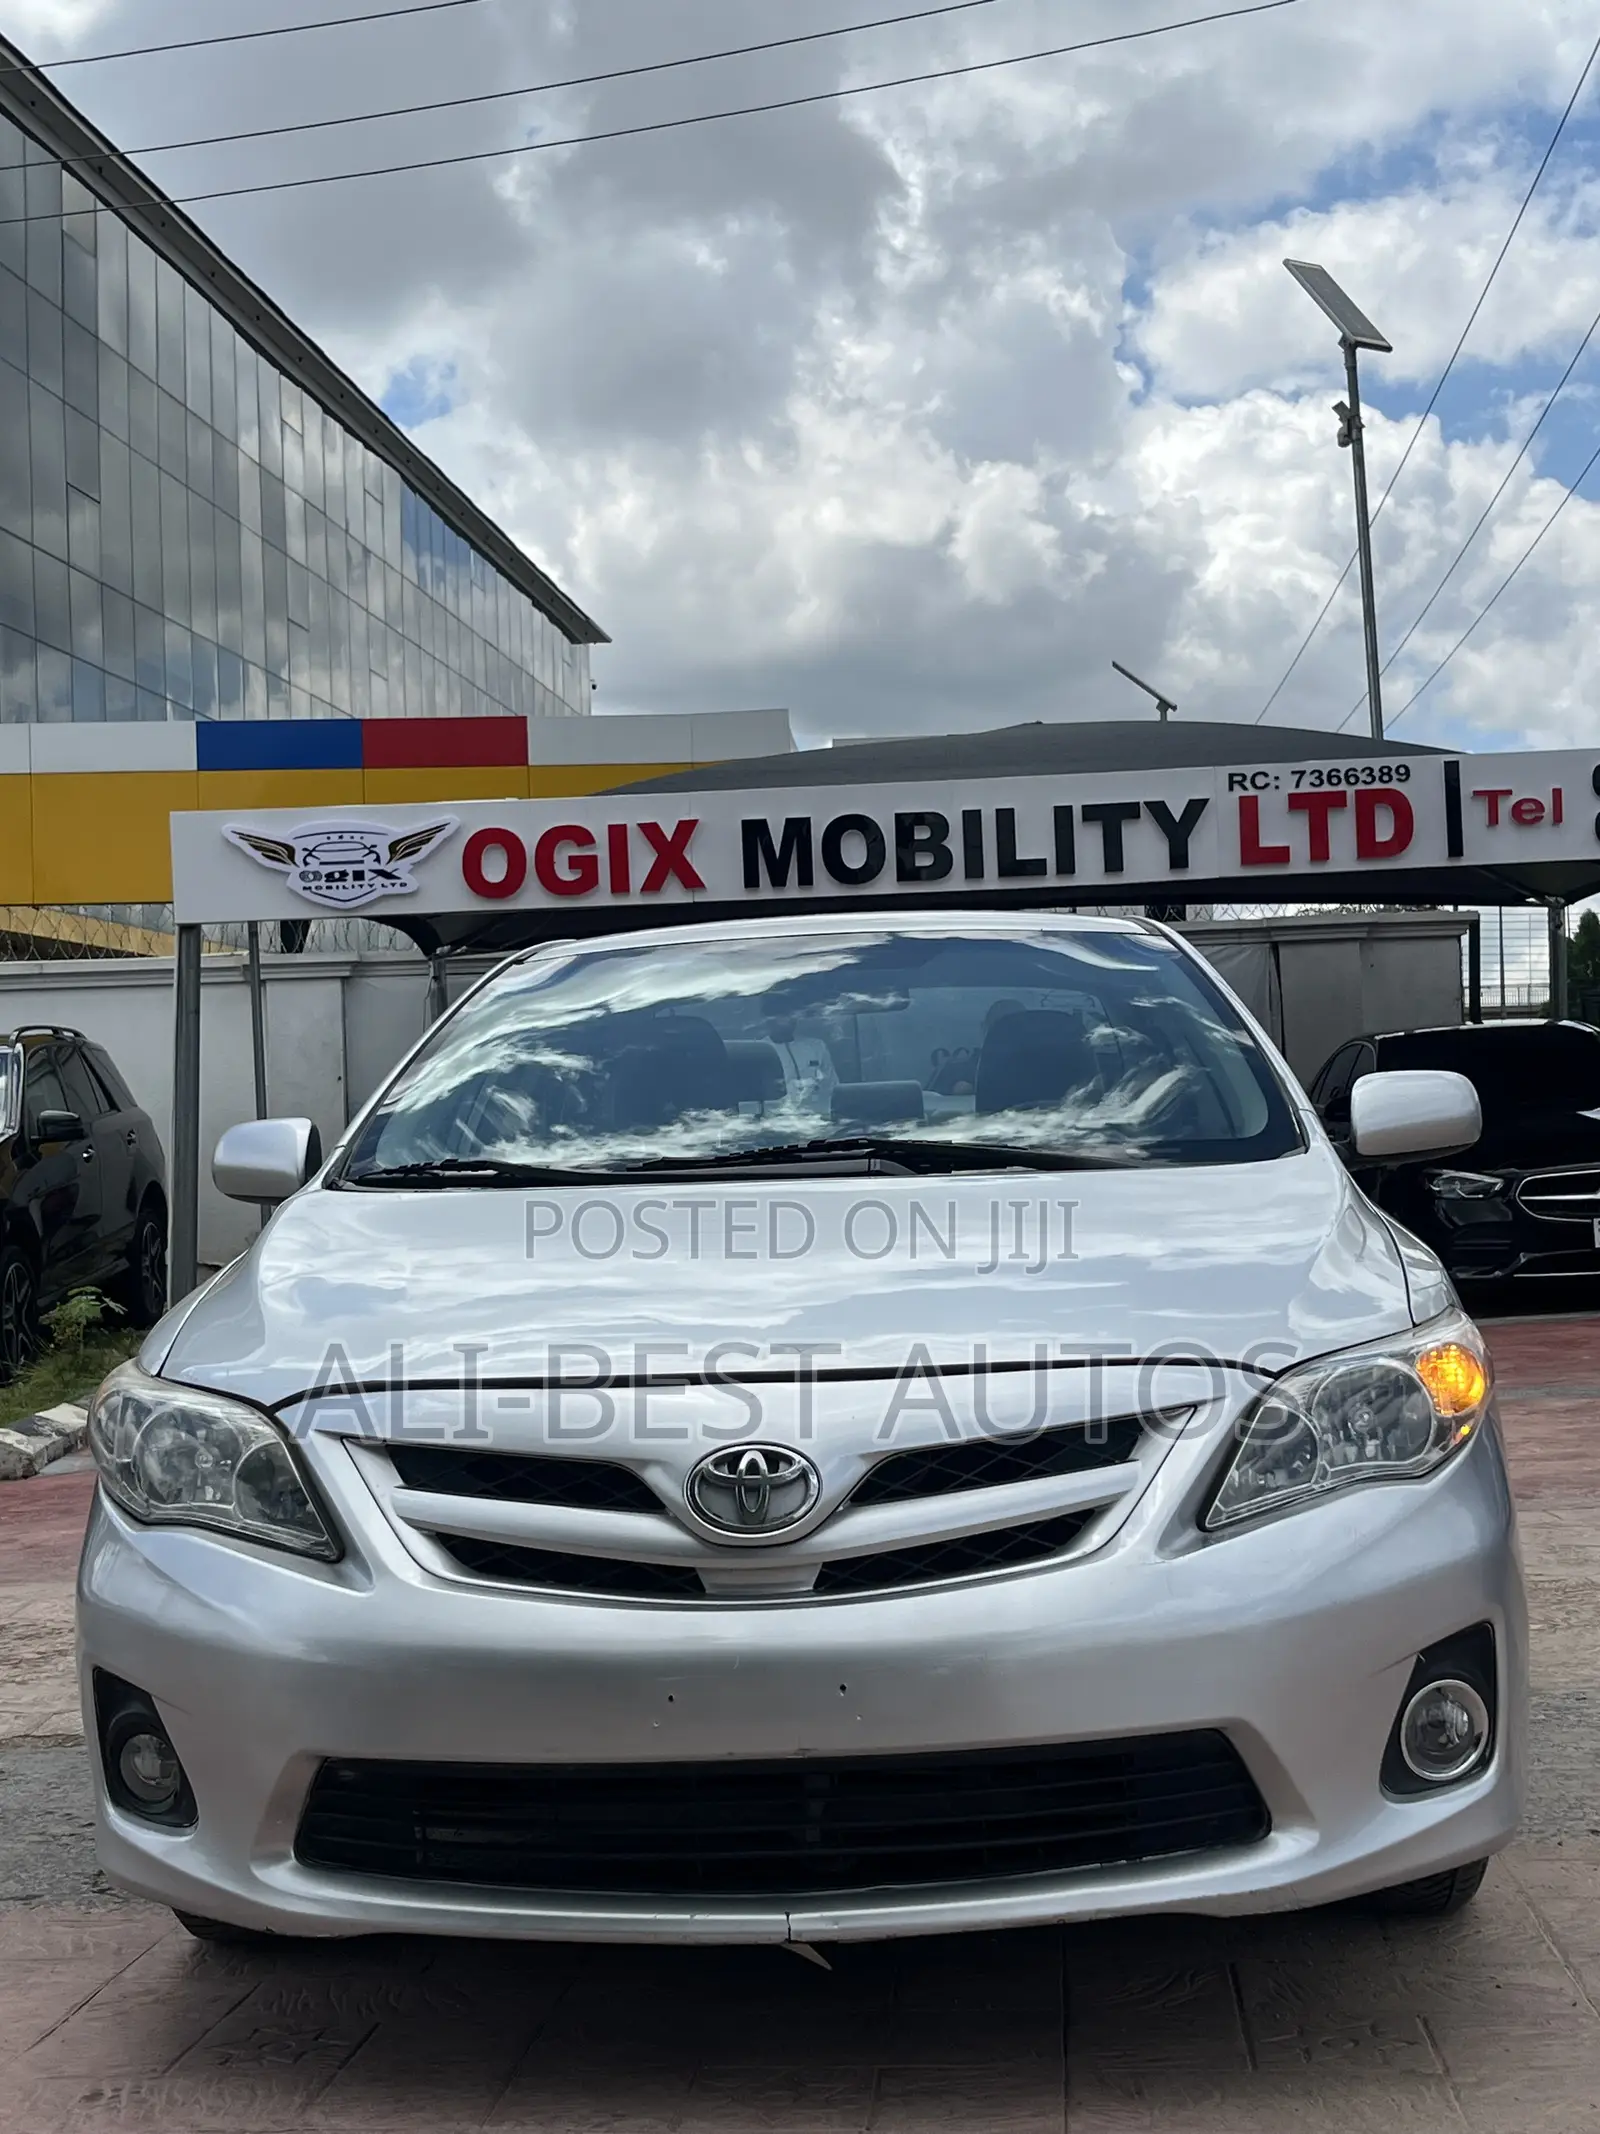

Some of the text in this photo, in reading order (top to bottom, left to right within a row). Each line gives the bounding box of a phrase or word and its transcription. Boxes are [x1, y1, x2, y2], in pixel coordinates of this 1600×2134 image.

[1228, 764, 1411, 792] RC: 7366389
[1472, 787, 1564, 827] Tel
[462, 787, 1415, 899] OGIX MOBILITY LTD
[302, 882, 375, 891] MOBILITY
